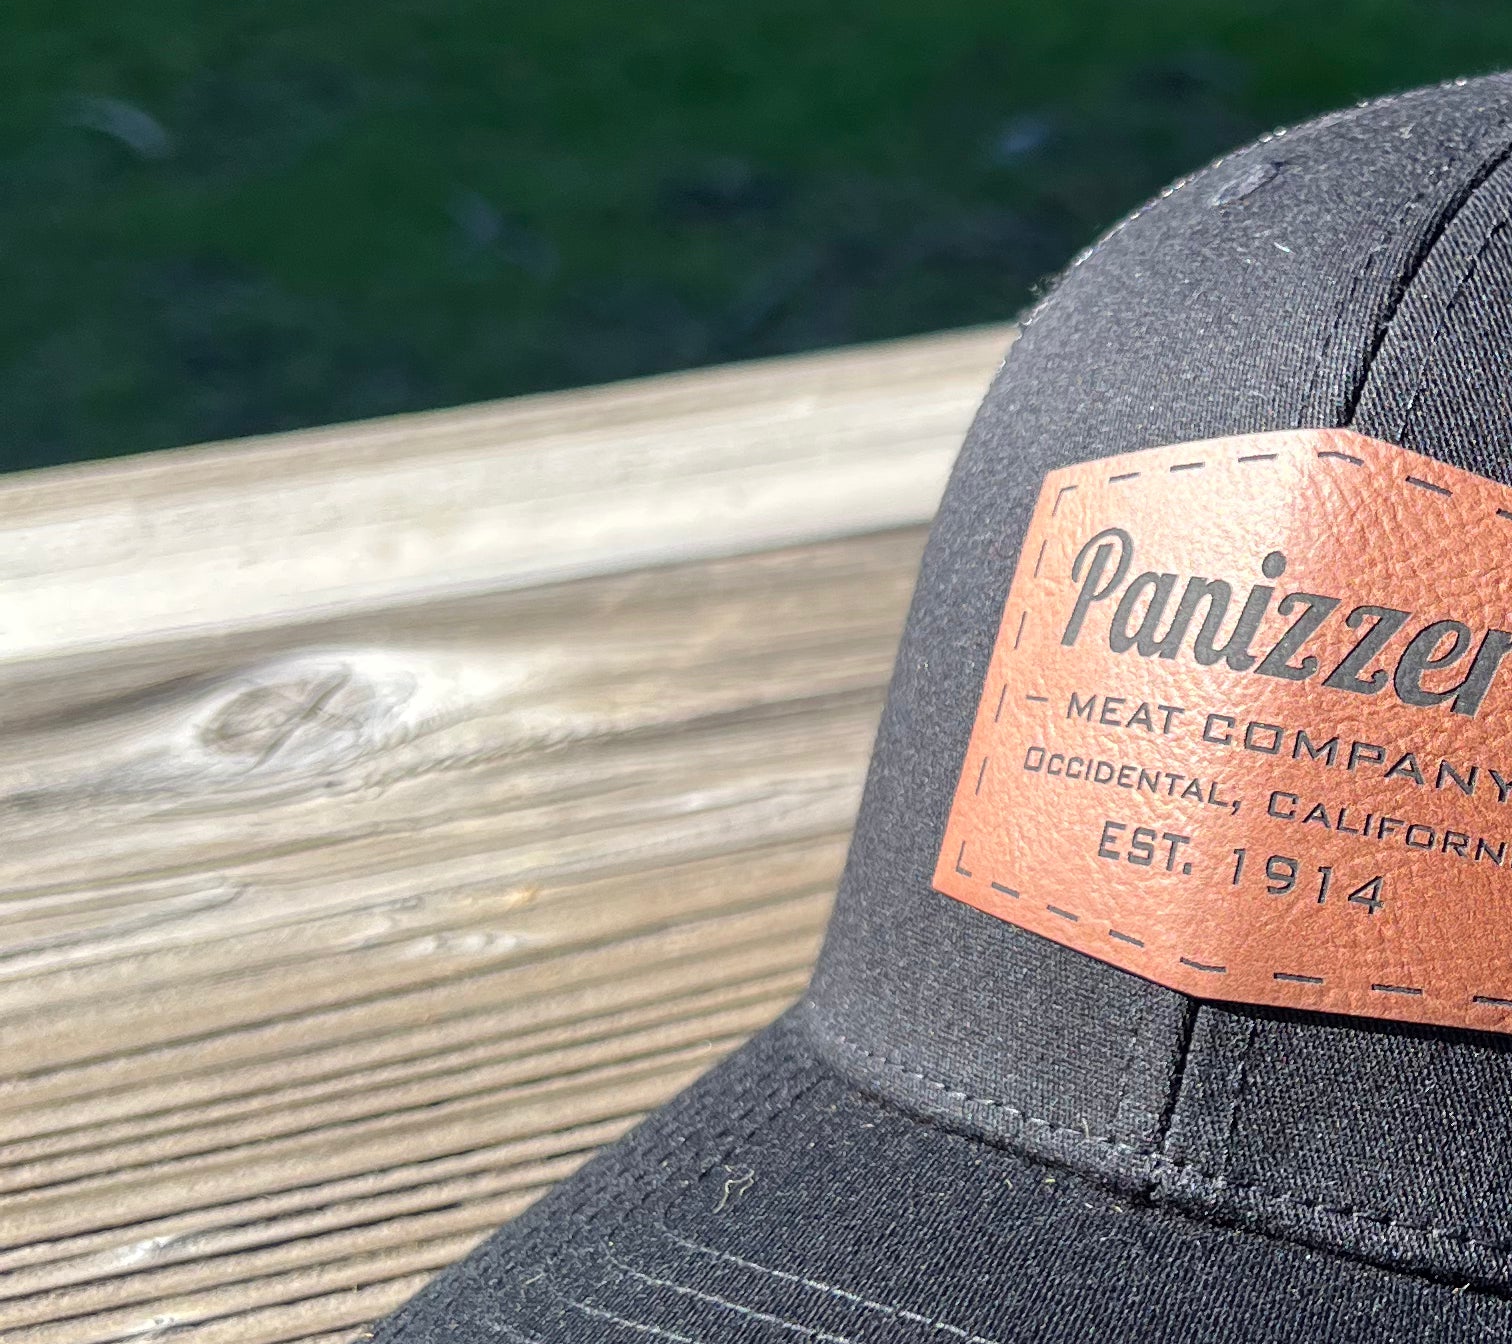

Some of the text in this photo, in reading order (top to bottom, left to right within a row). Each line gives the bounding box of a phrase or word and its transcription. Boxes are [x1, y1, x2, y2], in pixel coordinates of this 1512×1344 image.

[1066, 692, 1185, 736] MEAT
[1099, 821, 1386, 916] EST. 1914
